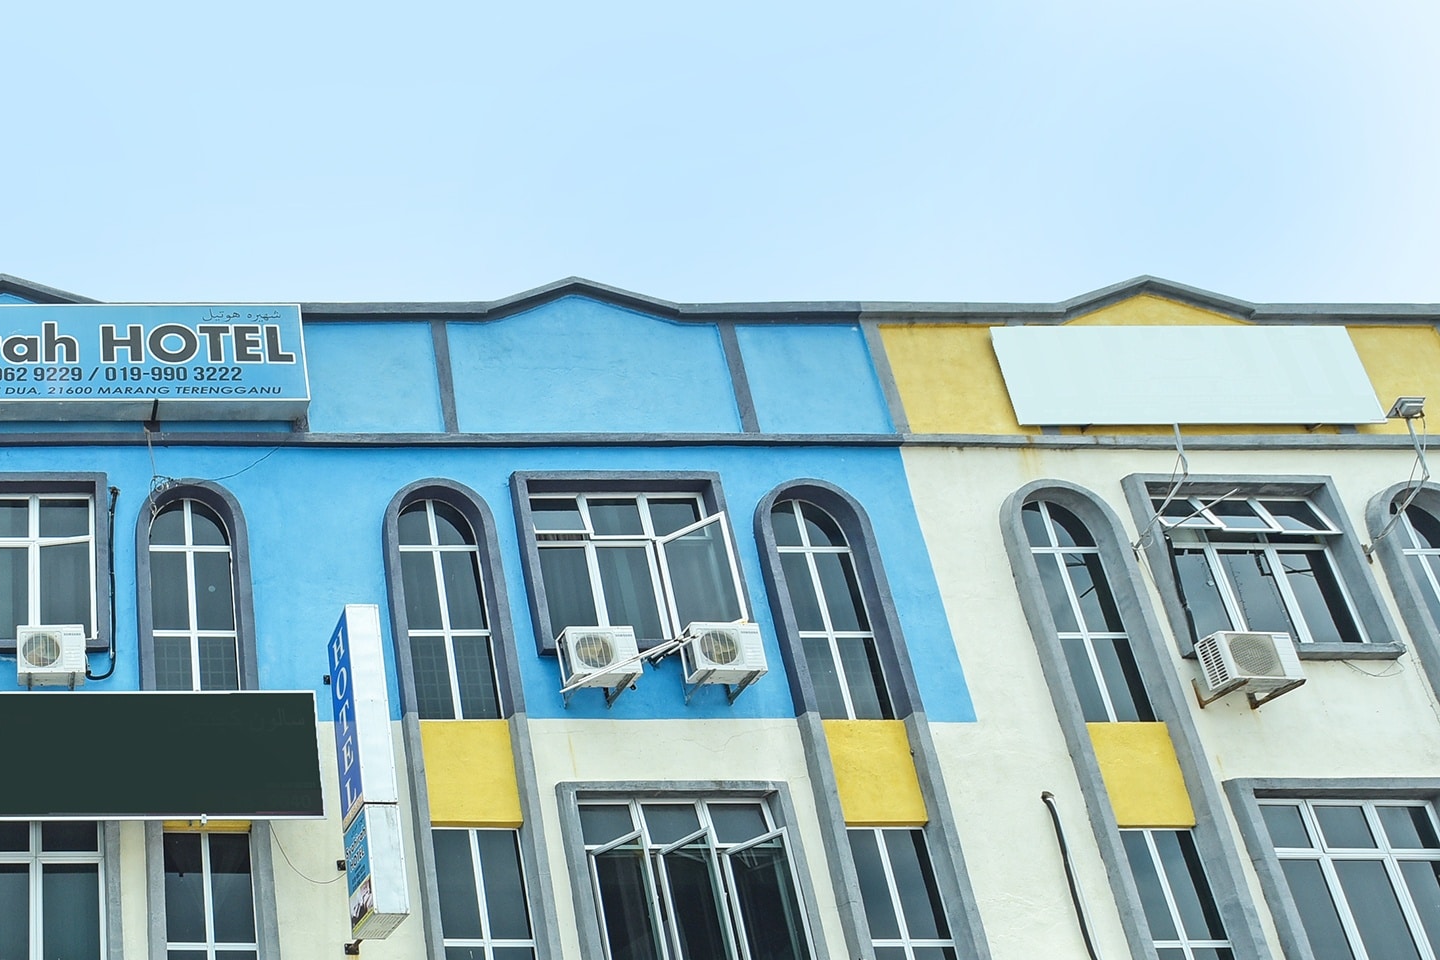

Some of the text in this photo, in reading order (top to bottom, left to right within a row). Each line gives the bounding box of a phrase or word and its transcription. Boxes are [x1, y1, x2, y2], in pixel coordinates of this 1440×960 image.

[101, 324, 295, 363] HOTEL
[34, 367, 82, 382] 9229
[105, 367, 188, 381] 019-990
[193, 366, 242, 381] 3222
[5, 387, 41, 395] DUA,
[47, 386, 93, 394] 21600
[97, 386, 170, 394] MARANG
[175, 386, 282, 394] TERENGGANU
[333, 627, 357, 812] HOTEL
